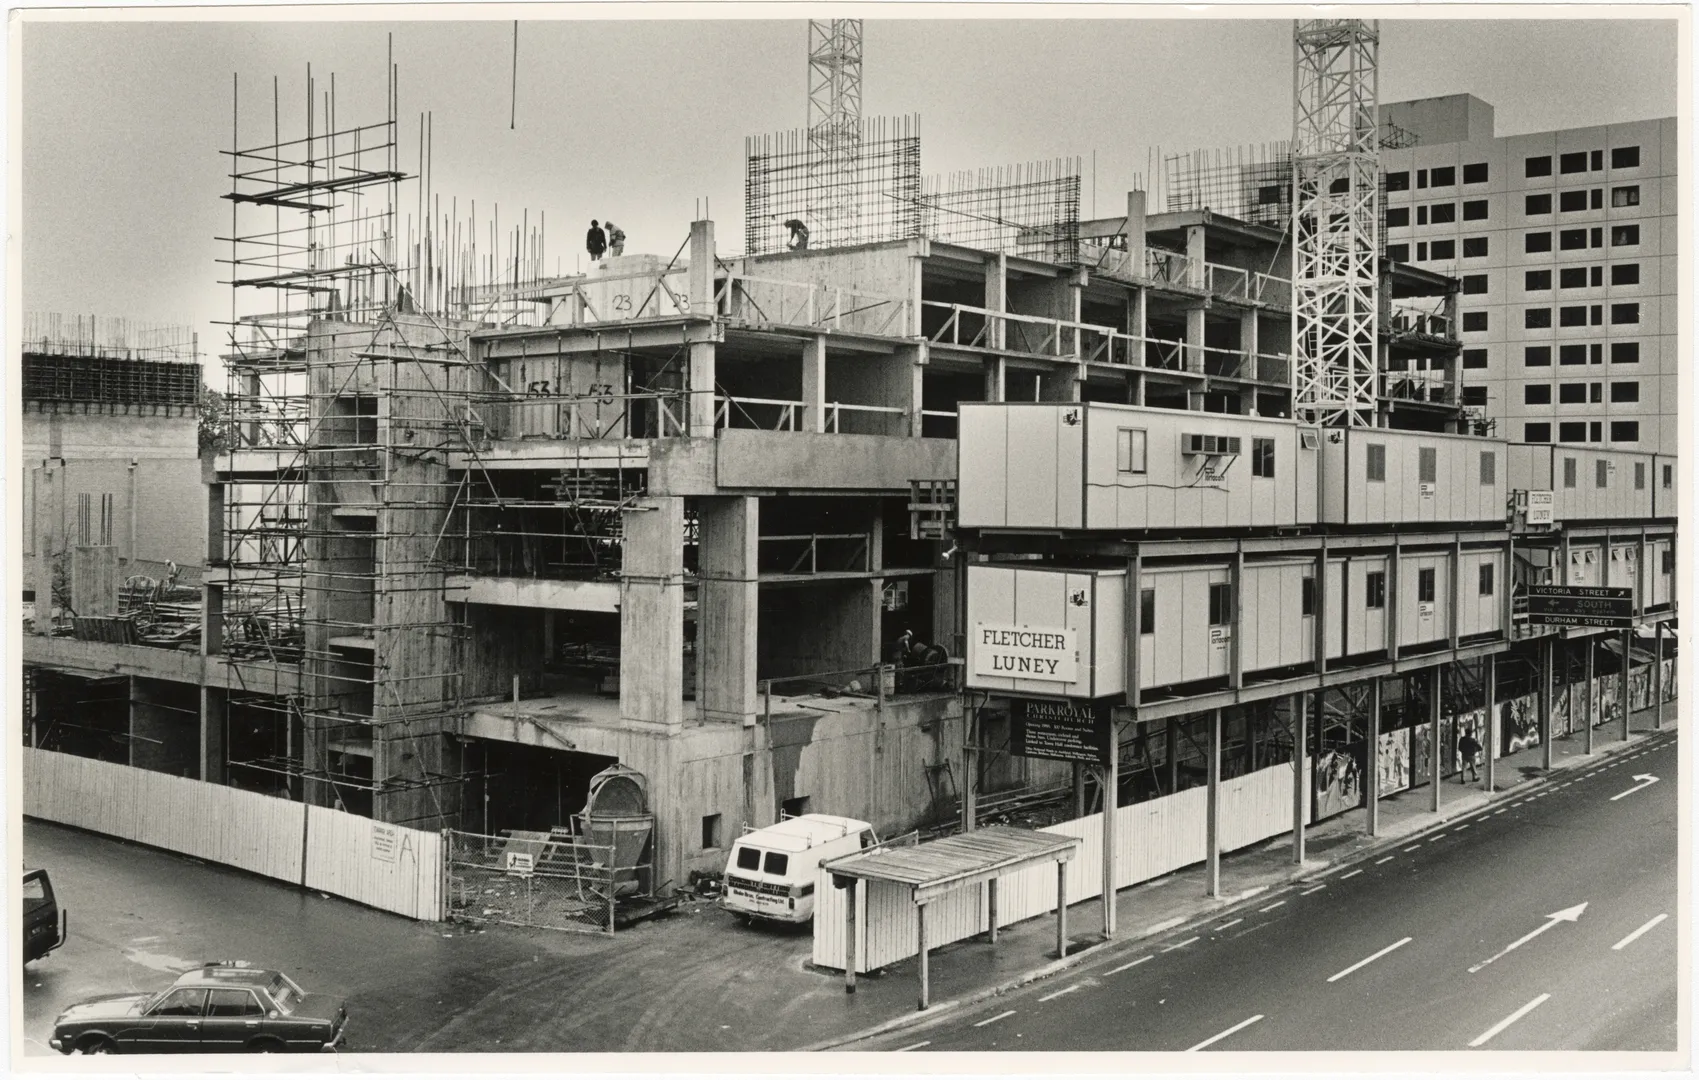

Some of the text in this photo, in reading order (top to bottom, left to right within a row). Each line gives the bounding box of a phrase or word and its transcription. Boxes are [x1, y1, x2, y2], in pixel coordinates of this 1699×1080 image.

[612, 294, 632, 311] 23
[1535, 587, 1610, 597] VICTORIA STREET
[1577, 600, 1612, 609] SOUTH
[1544, 616, 1615, 626] DURHAM STREET
[982, 629, 1066, 650] FLETCHER
[992, 655, 1060, 675] LUNEY
[1026, 702, 1096, 720] PARKROYAL
